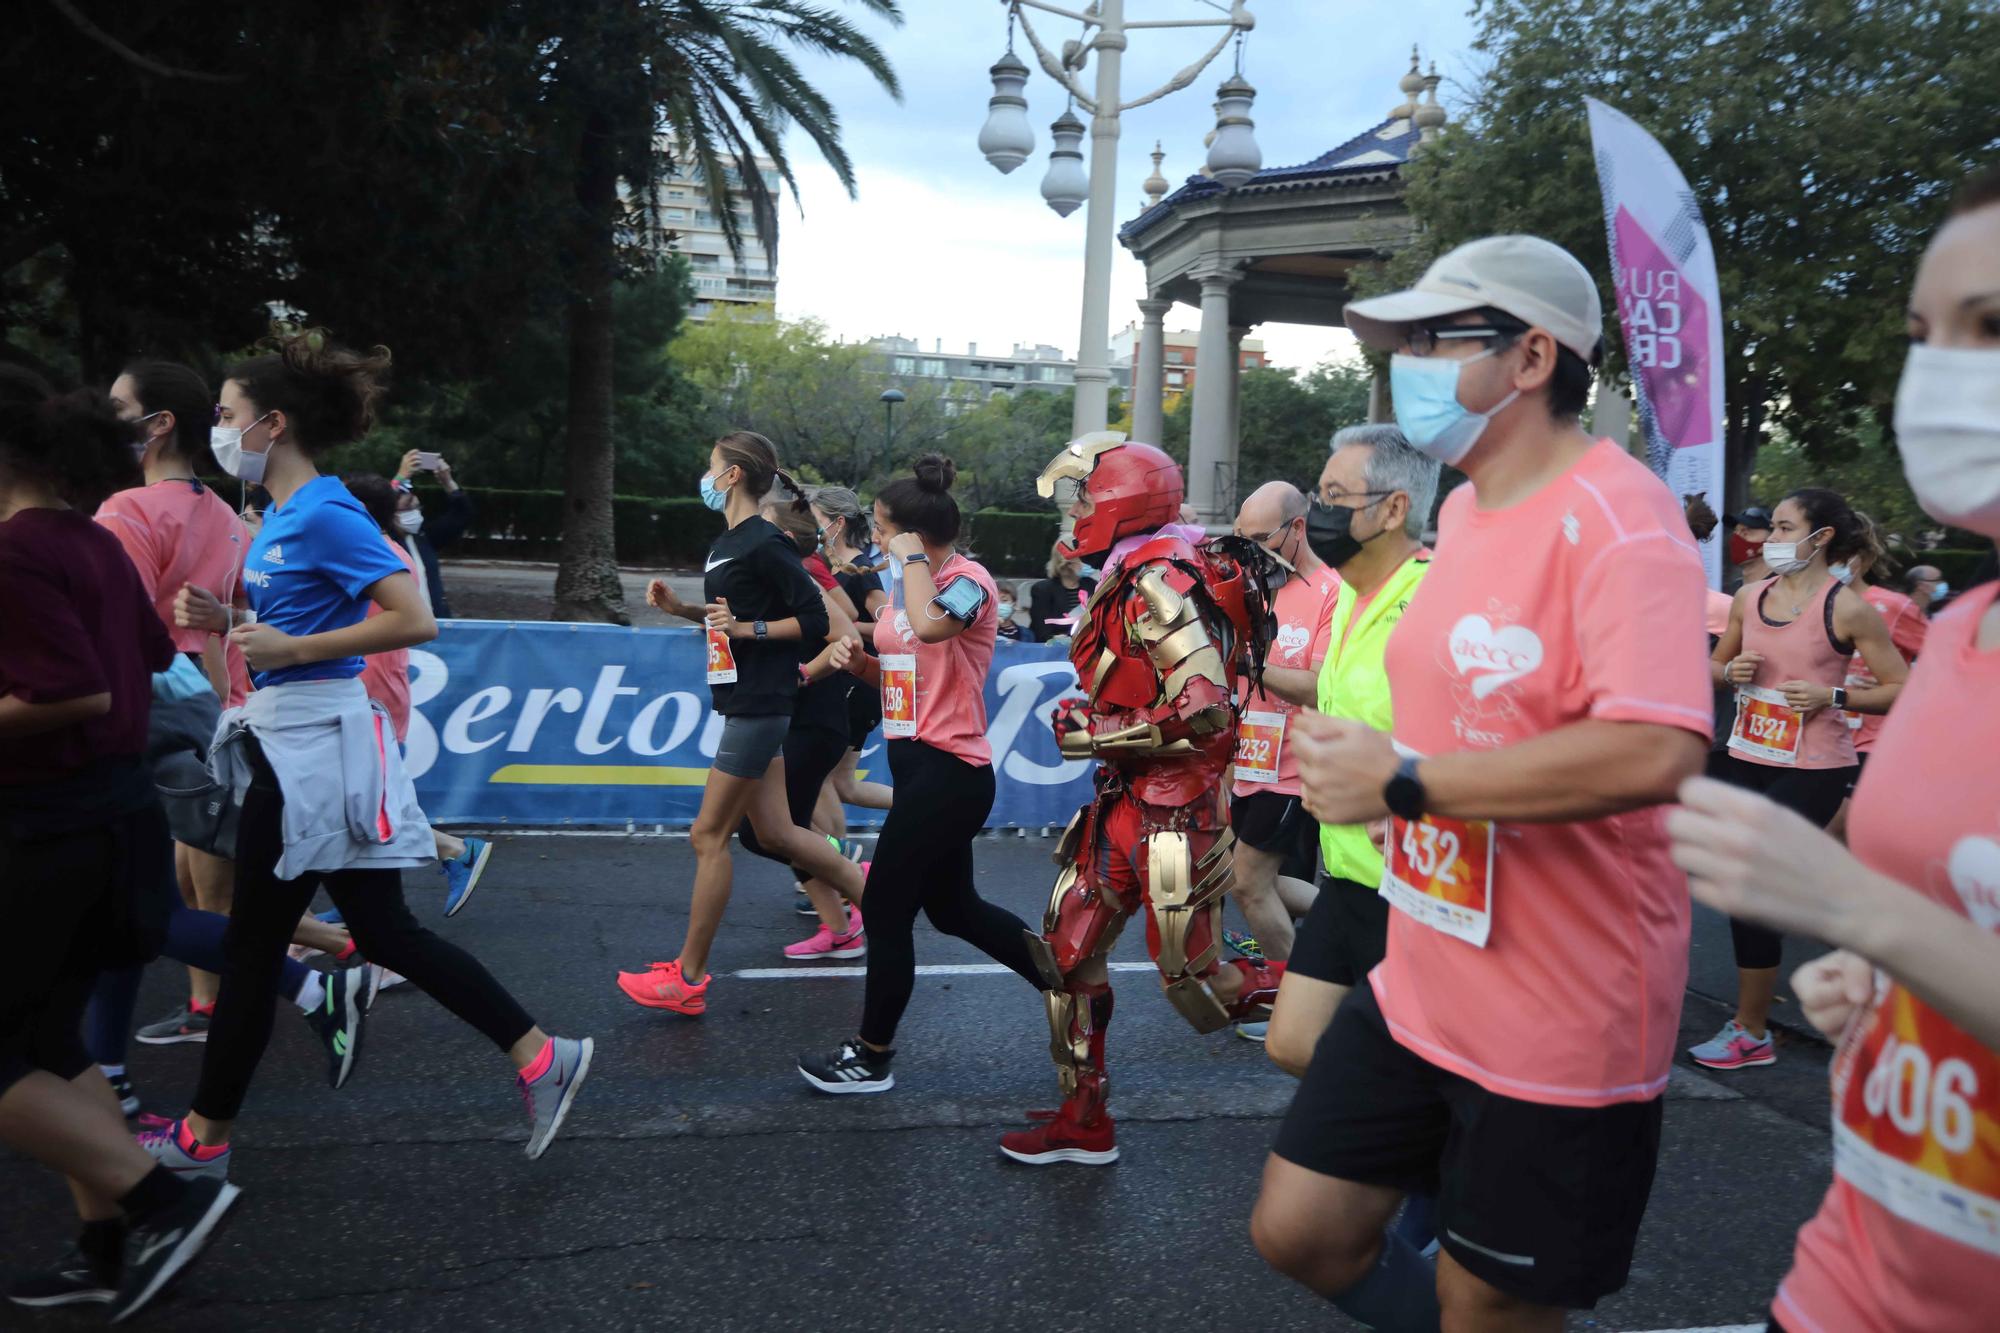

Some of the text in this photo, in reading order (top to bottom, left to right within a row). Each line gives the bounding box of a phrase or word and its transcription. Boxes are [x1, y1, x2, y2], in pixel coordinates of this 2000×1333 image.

[885, 686, 904, 712] 238
[1748, 713, 1788, 742] 1321
[1401, 820, 1460, 886] 432
